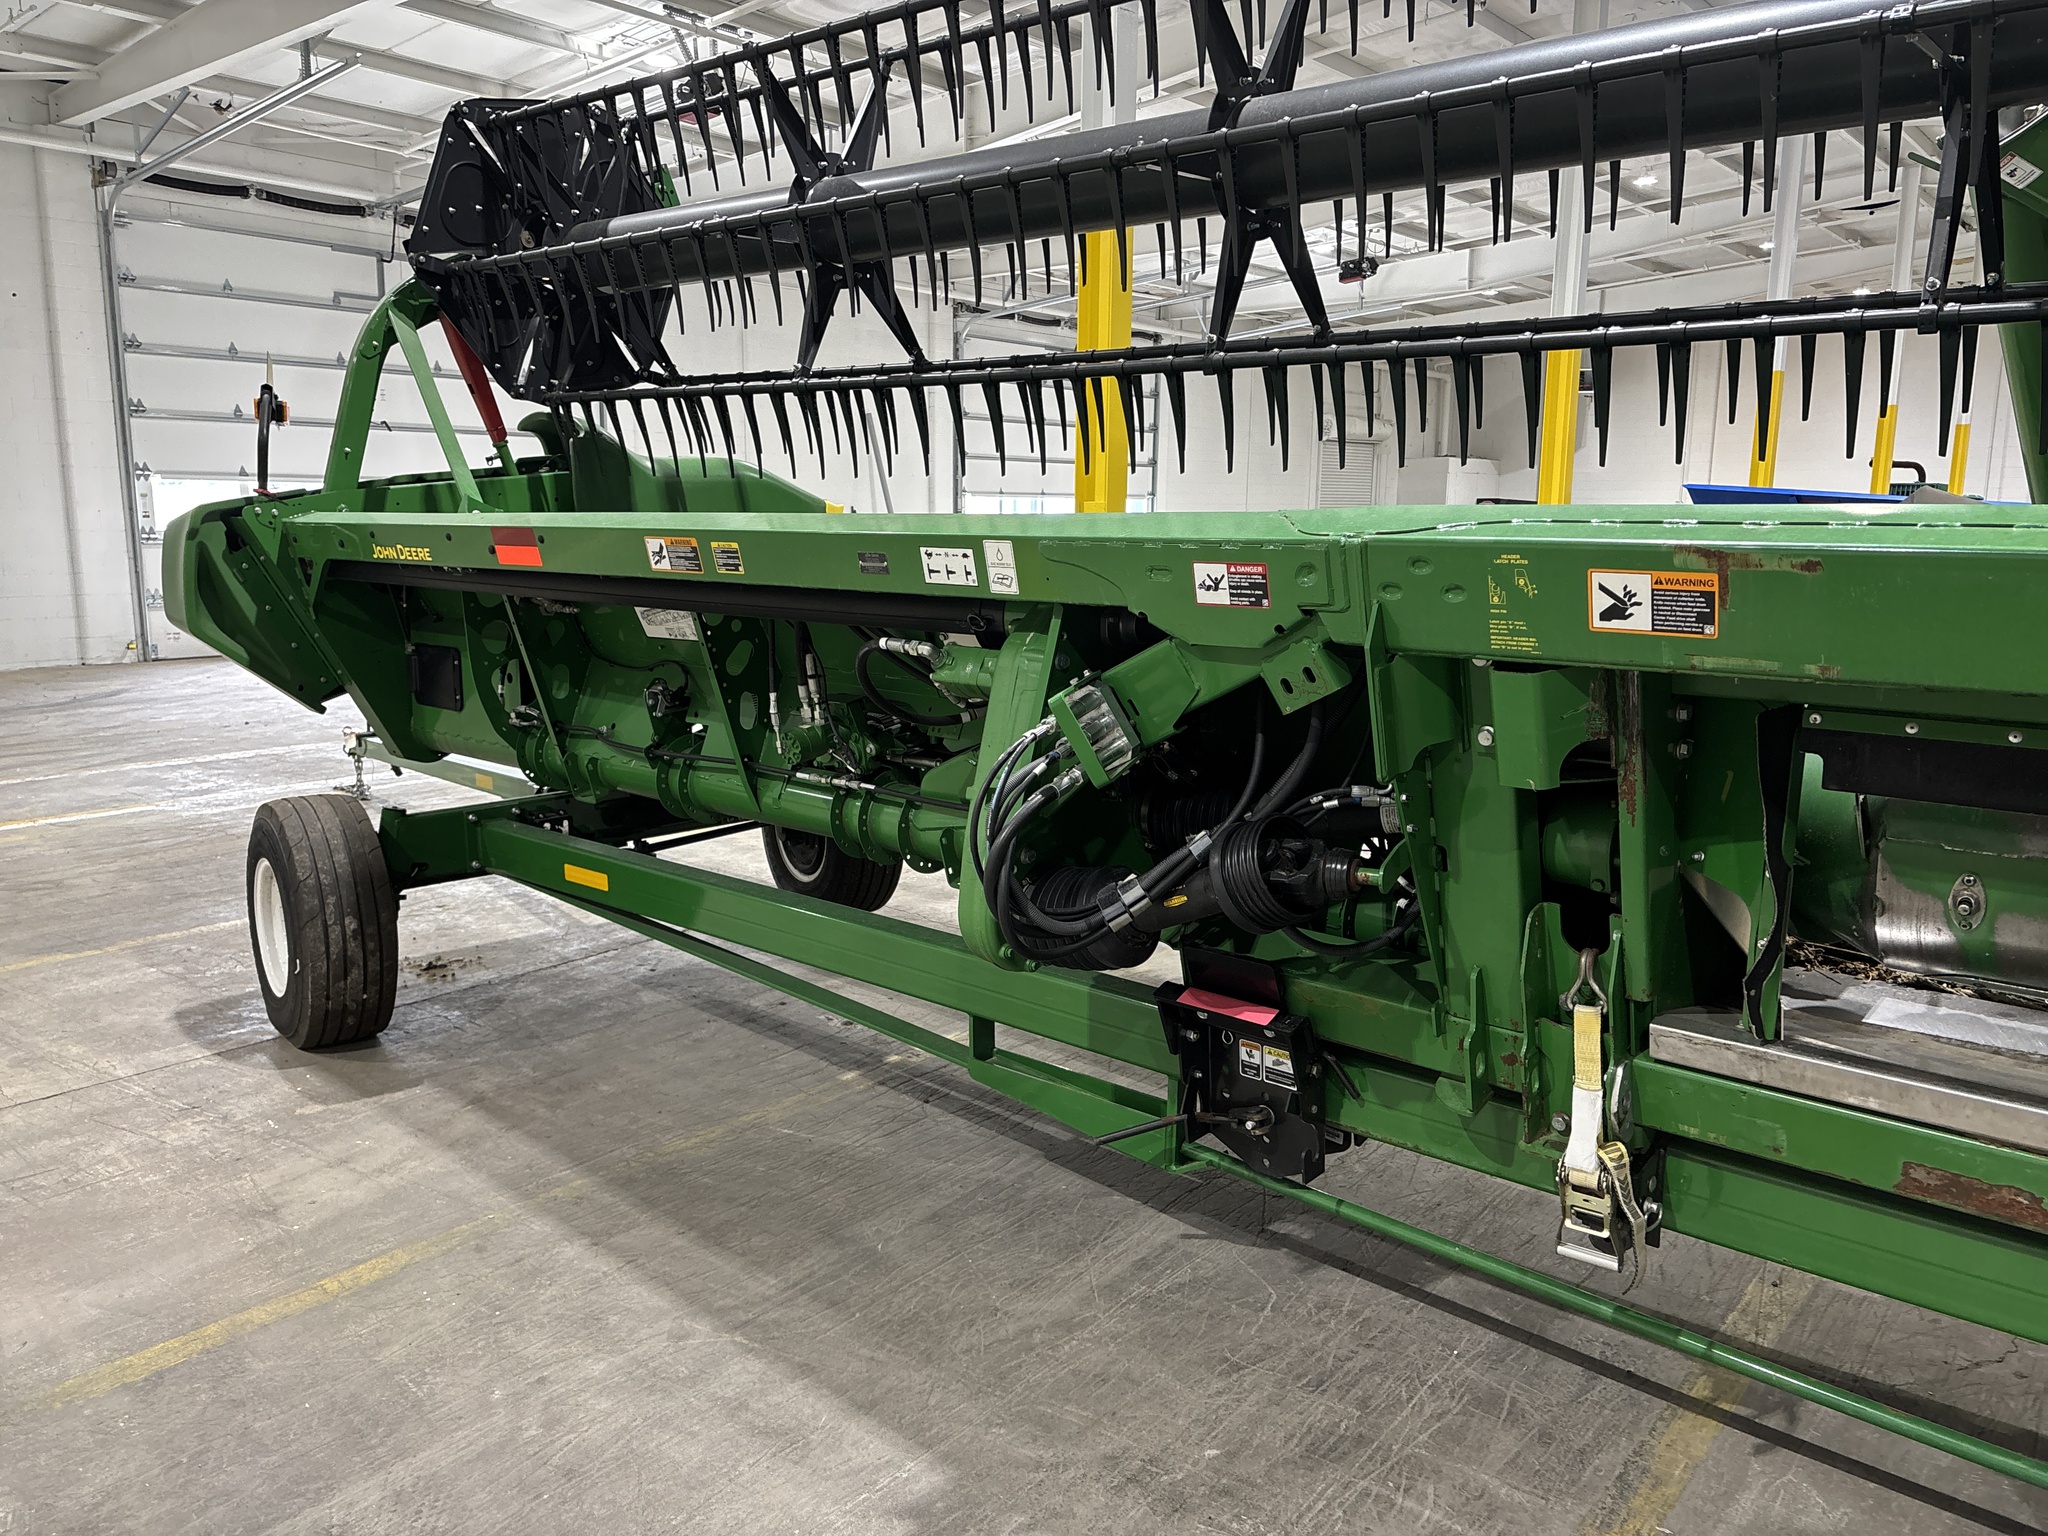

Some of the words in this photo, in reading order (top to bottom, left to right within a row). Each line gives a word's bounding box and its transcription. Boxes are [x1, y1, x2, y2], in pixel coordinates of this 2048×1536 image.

[372, 543, 397, 560] JOHN
[396, 544, 432, 561] DEERE
[1664, 578, 1714, 587] WARNING
